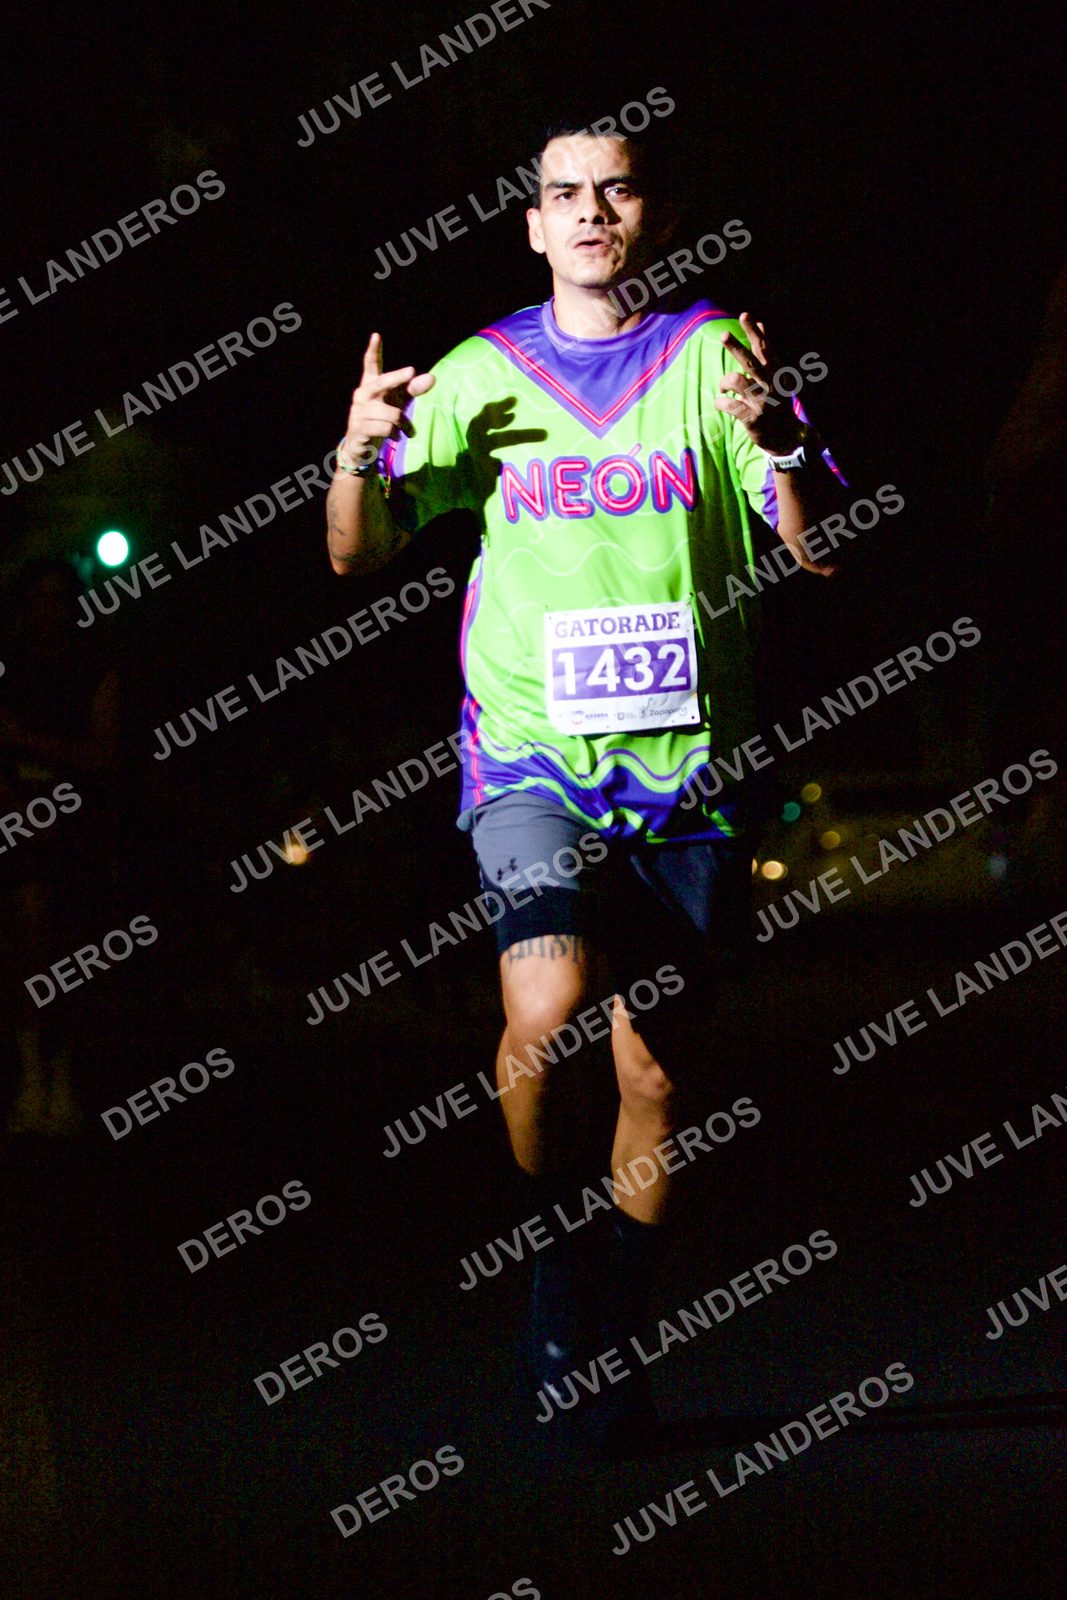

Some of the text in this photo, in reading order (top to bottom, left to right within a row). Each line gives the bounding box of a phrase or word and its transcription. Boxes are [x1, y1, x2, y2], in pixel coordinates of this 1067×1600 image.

[501, 443, 698, 524] NEÓN
[554, 612, 681, 638] GATORADE
[556, 643, 688, 695] 1432
